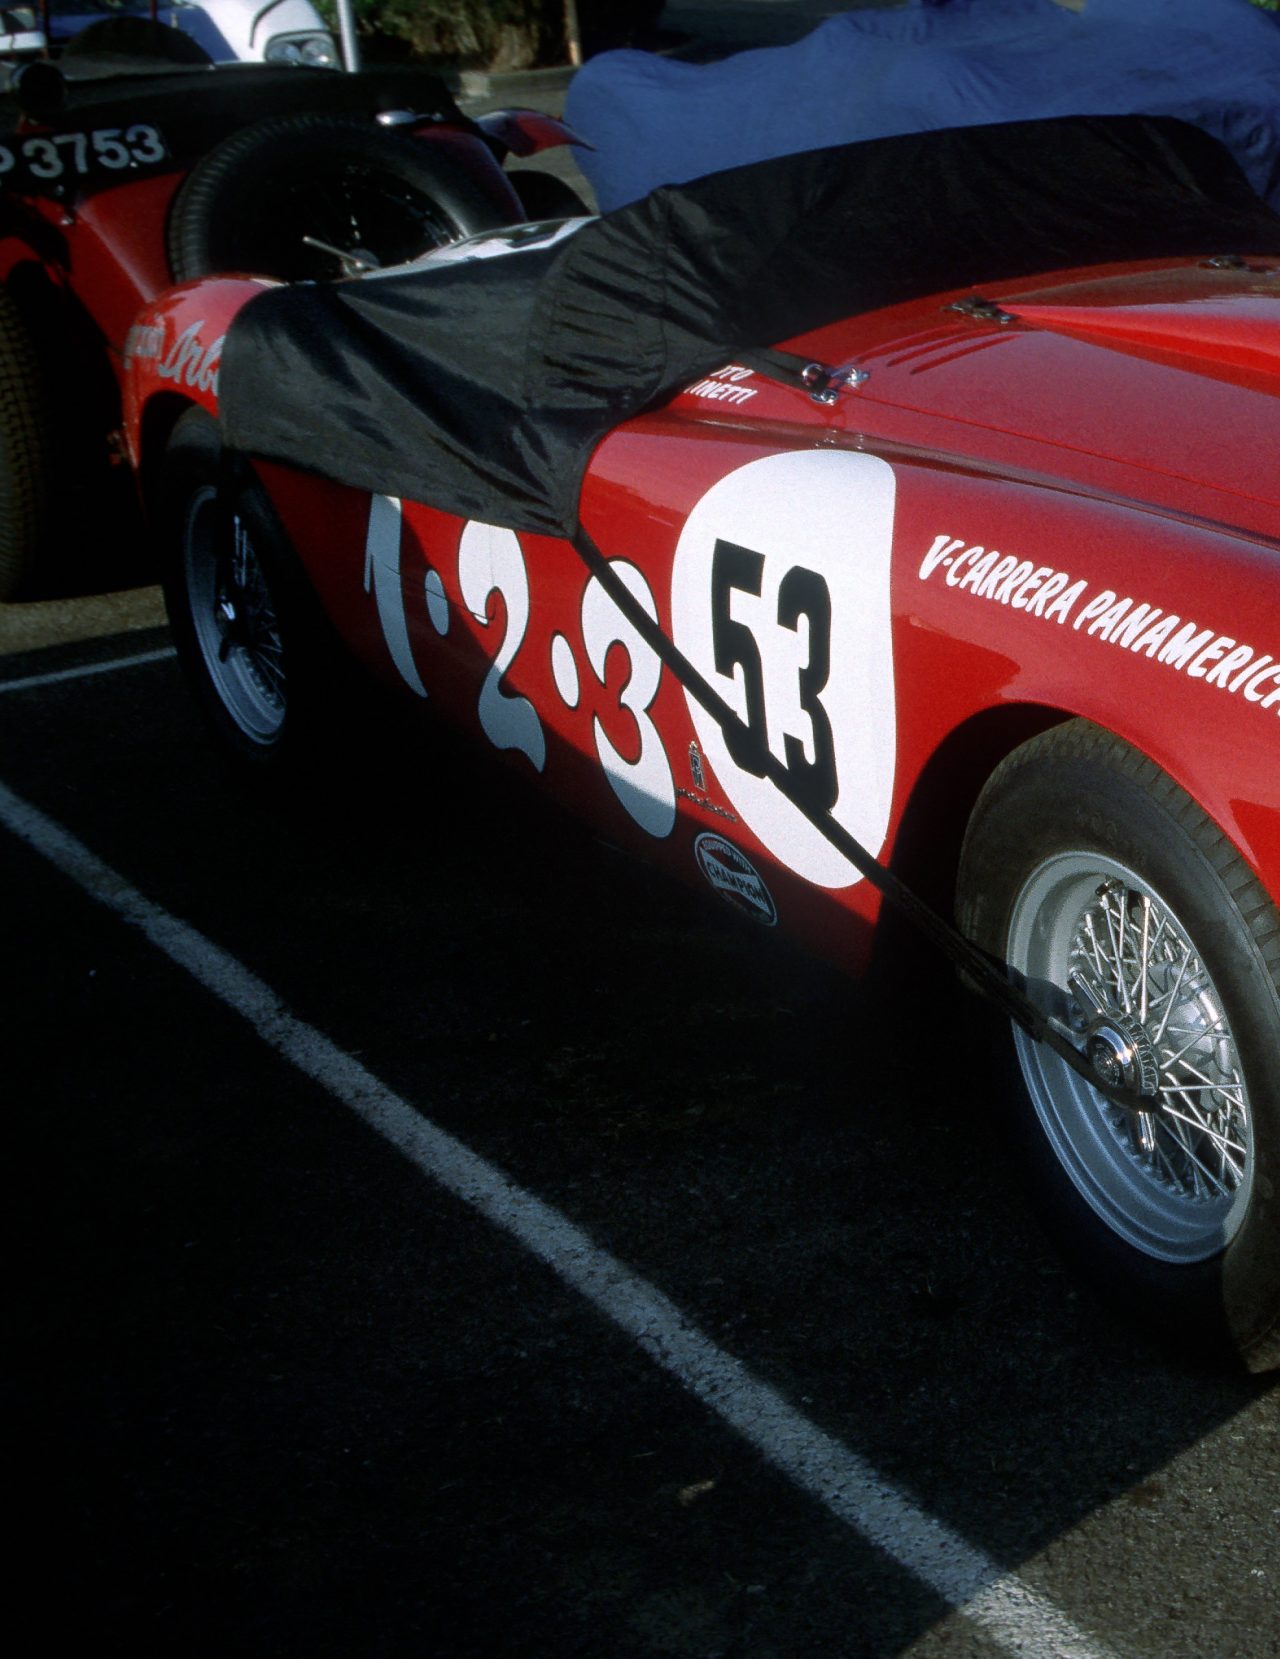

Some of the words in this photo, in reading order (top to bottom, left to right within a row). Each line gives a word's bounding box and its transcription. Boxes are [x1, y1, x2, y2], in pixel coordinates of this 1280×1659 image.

[22, 124, 165, 178] 3753
[710, 537, 841, 814] 53
[706, 862, 767, 904] CHAMPION
